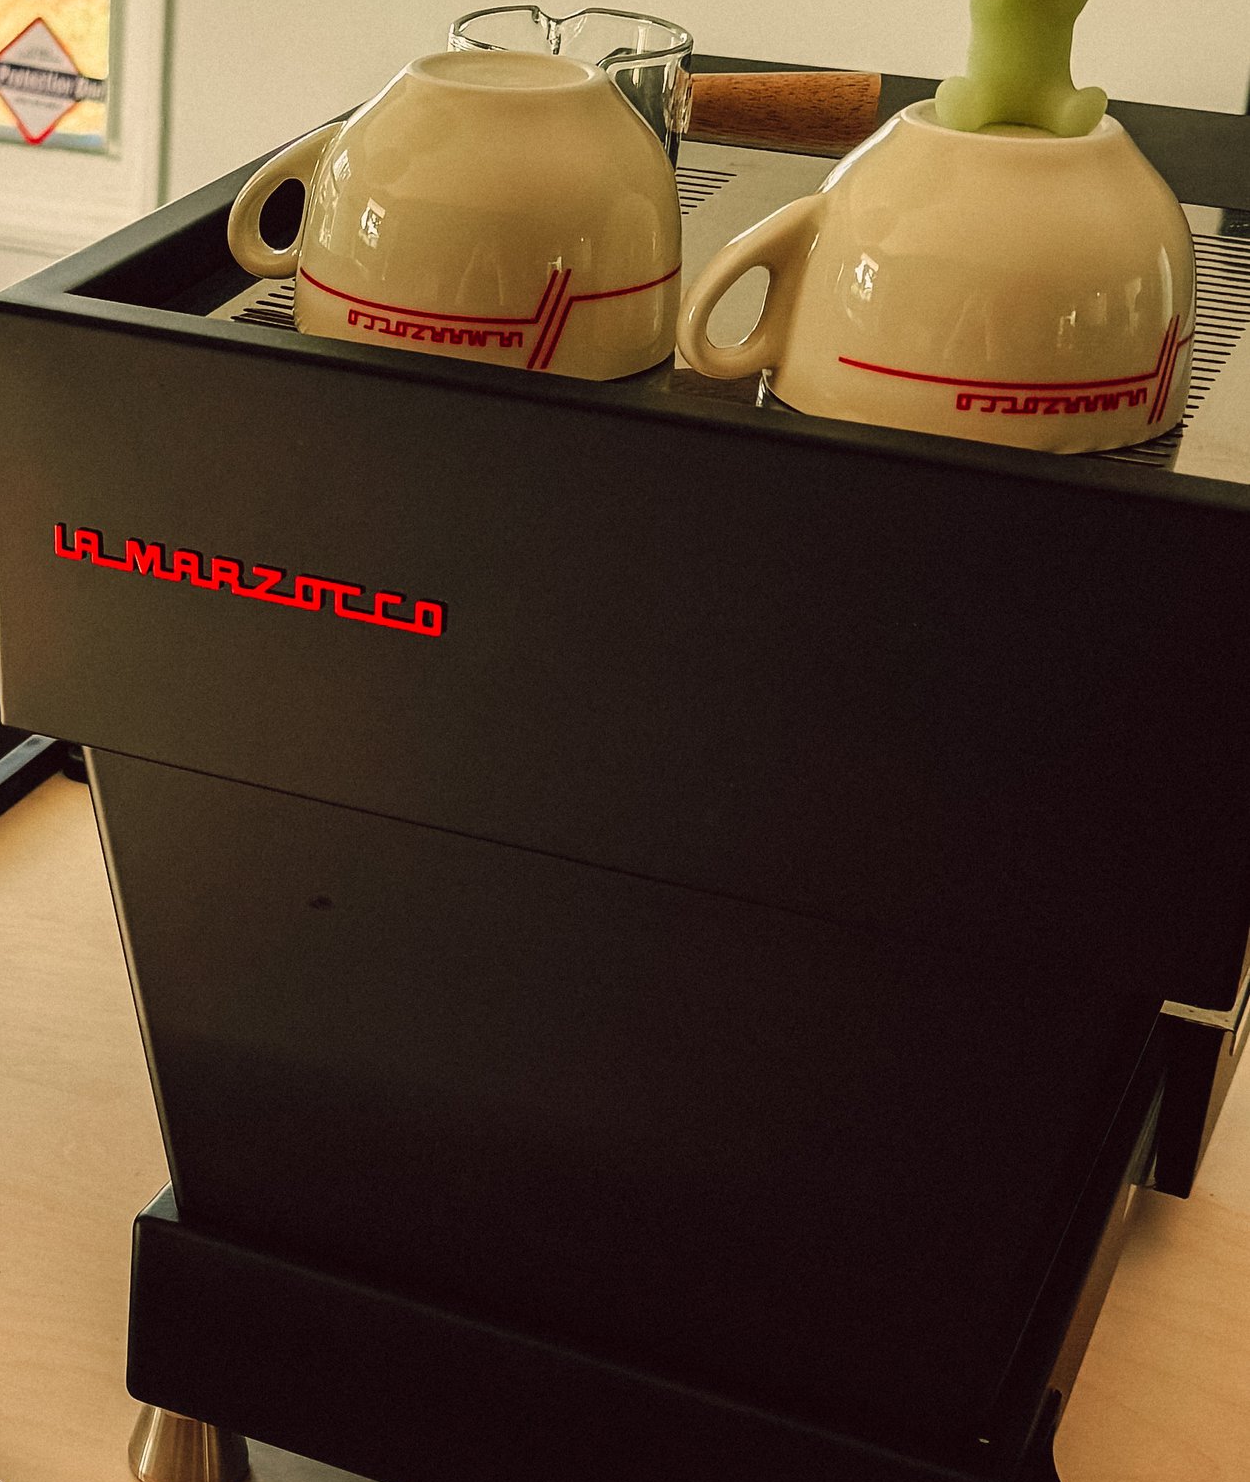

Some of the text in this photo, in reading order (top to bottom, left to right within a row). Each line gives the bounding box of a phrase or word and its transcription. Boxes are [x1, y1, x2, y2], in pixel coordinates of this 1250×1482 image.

[348, 308, 488, 348] MARZOCCO
[956, 391, 1120, 416] MARZOCCO
[126, 539, 446, 638] MARZOCCO
